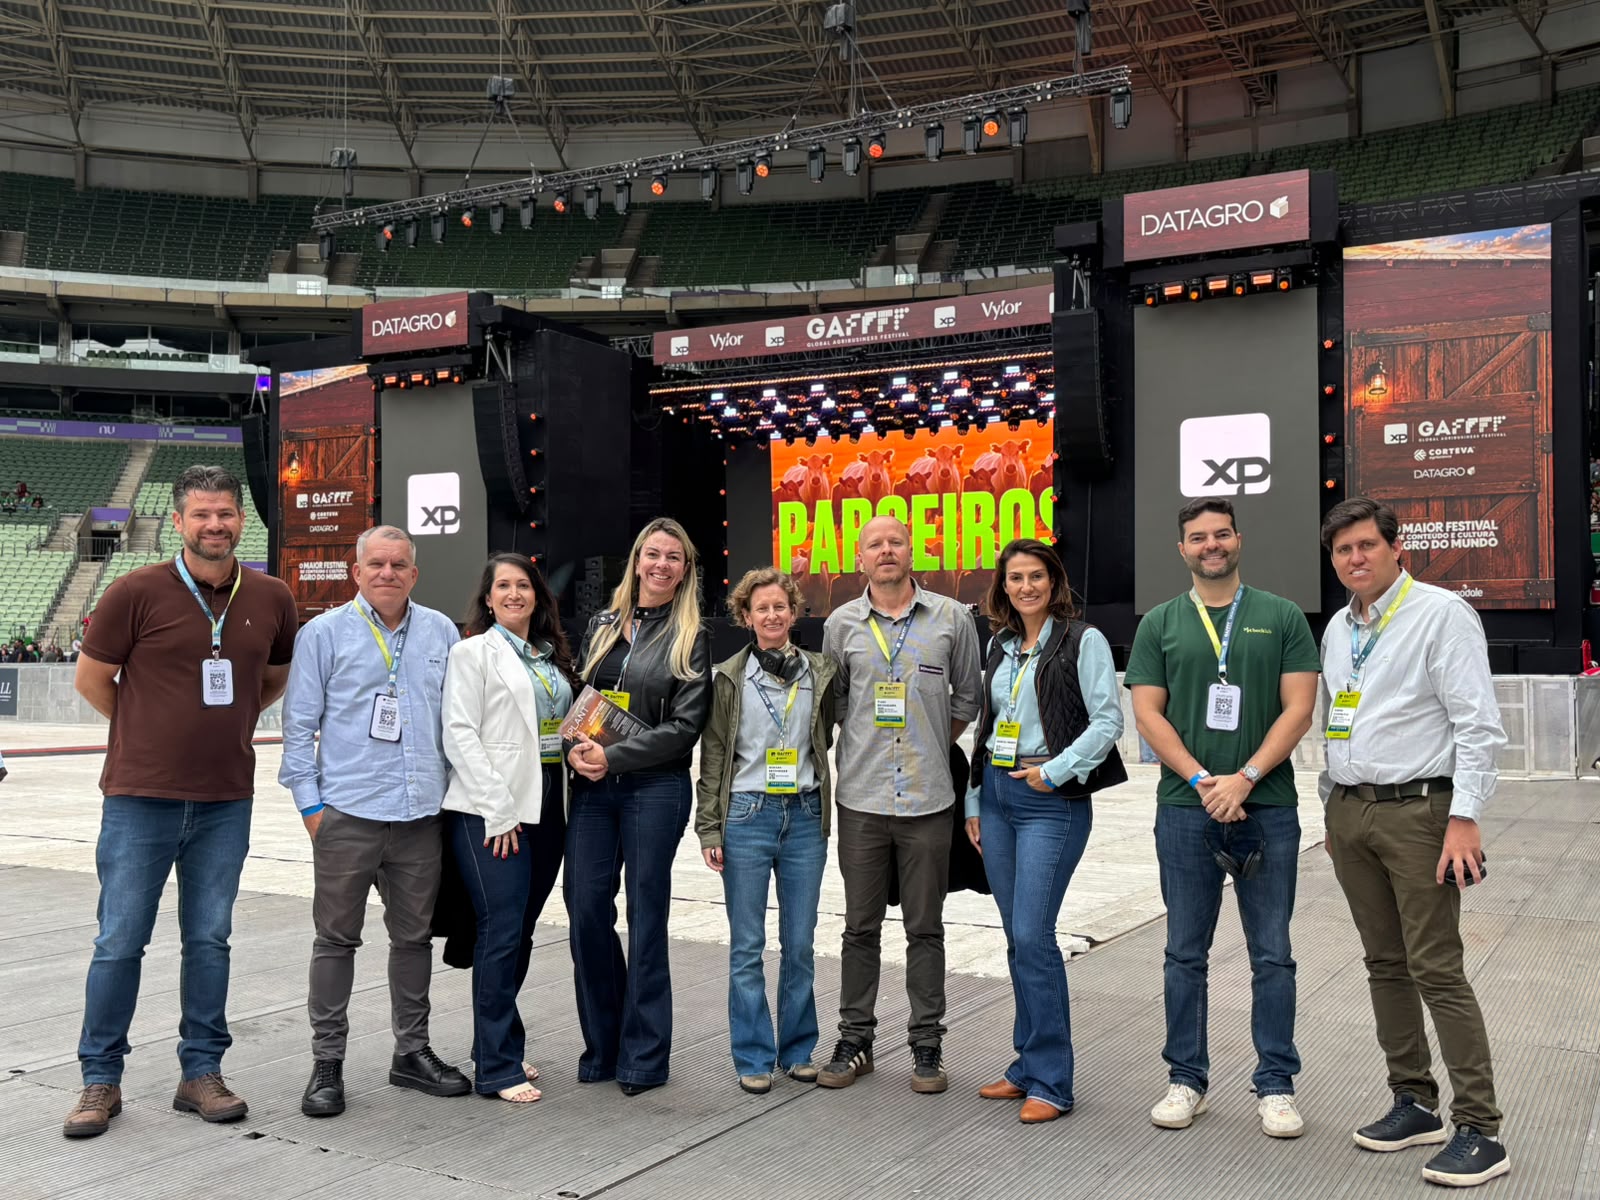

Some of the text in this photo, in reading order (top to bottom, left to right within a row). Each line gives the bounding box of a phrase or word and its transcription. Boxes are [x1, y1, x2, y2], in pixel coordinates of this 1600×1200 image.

[1141, 200, 1264, 236] DATAGRO
[372, 312, 443, 337] DATAGRO
[832, 335, 878, 346] AGRIBUSINESS
[880, 332, 910, 340] FESTIVAL
[1428, 446, 1475, 456] CORTEVA
[1413, 466, 1466, 479] DATAGRO
[779, 485, 1053, 575] PAREIRO
[1402, 521, 1444, 534] MAIOR
[1445, 519, 1499, 532] FESTIVAL
[1451, 532, 1456, 540] E
[1457, 530, 1495, 539] CULTURA
[1401, 538, 1499, 551] GRO DO MUNDO
